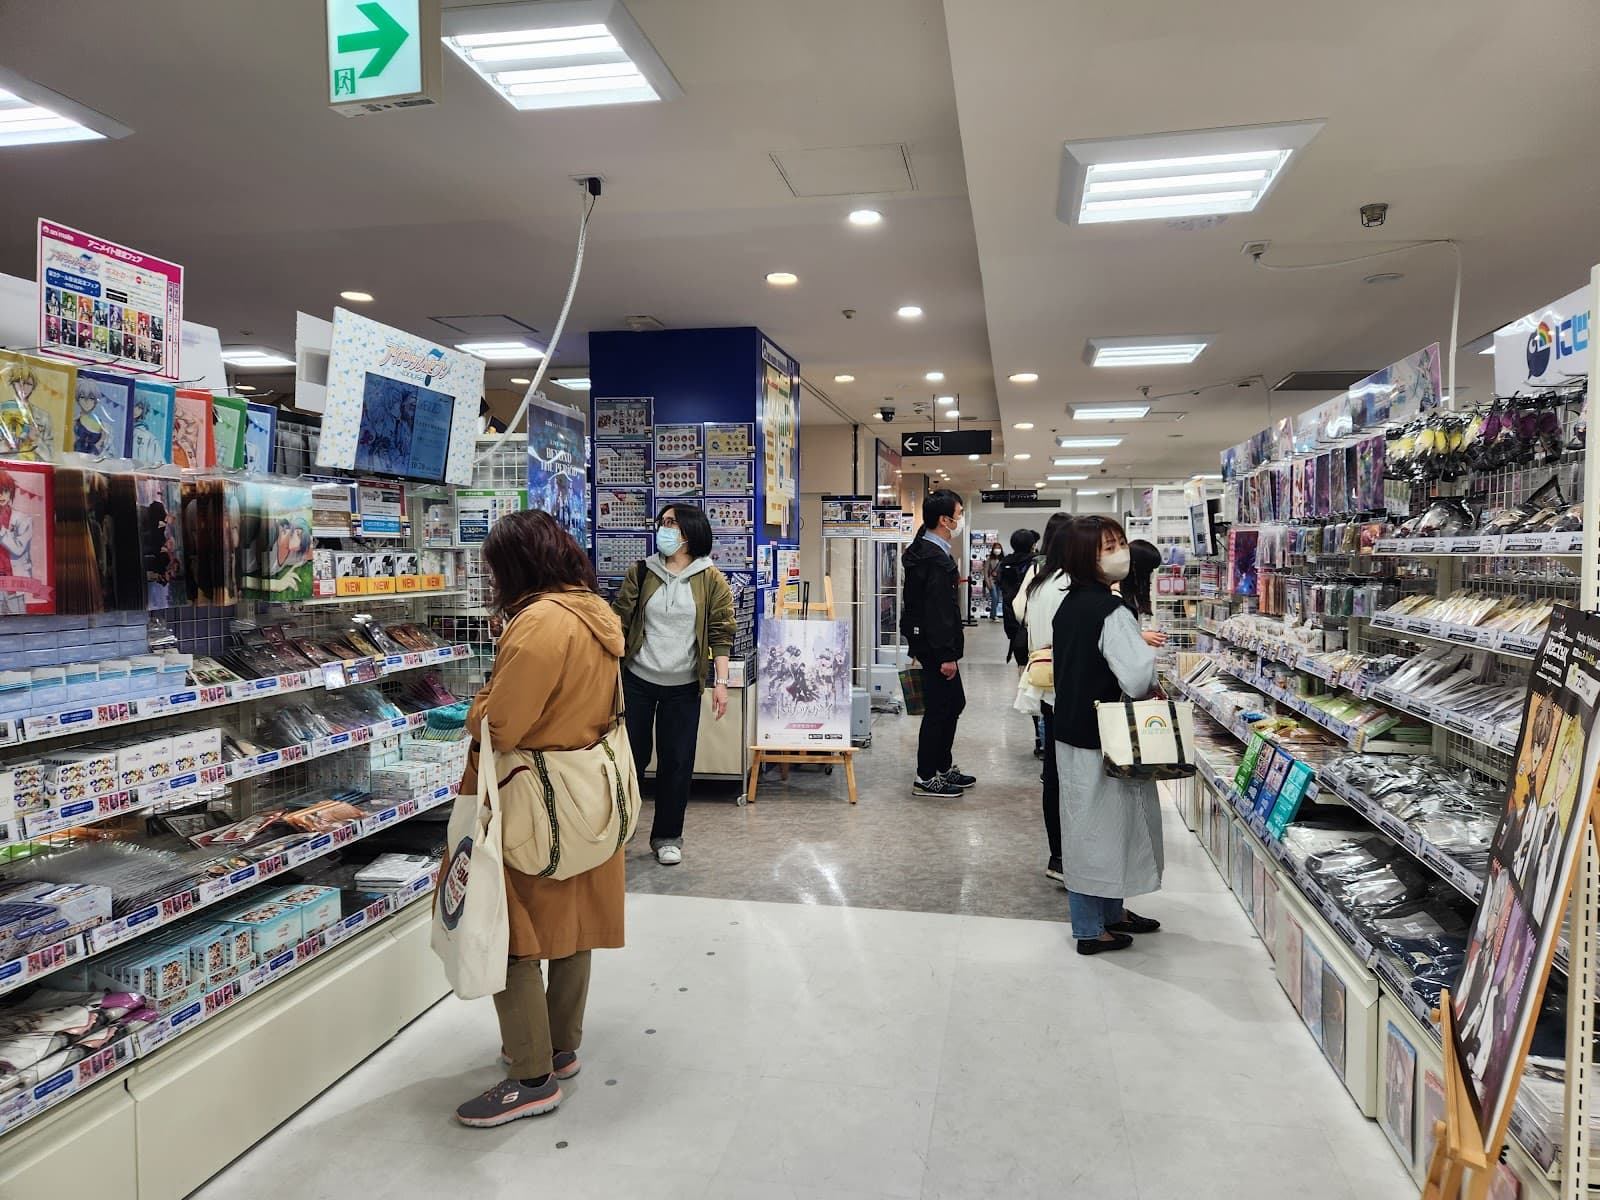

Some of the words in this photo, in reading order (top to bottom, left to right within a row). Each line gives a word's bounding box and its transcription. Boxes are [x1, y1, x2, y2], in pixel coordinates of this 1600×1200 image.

[1555, 310, 1590, 360] にじ
[345, 581, 360, 592] NEW
[374, 581, 390, 590] NEW
[402, 578, 416, 588] NEW
[427, 577, 440, 587] NEW
